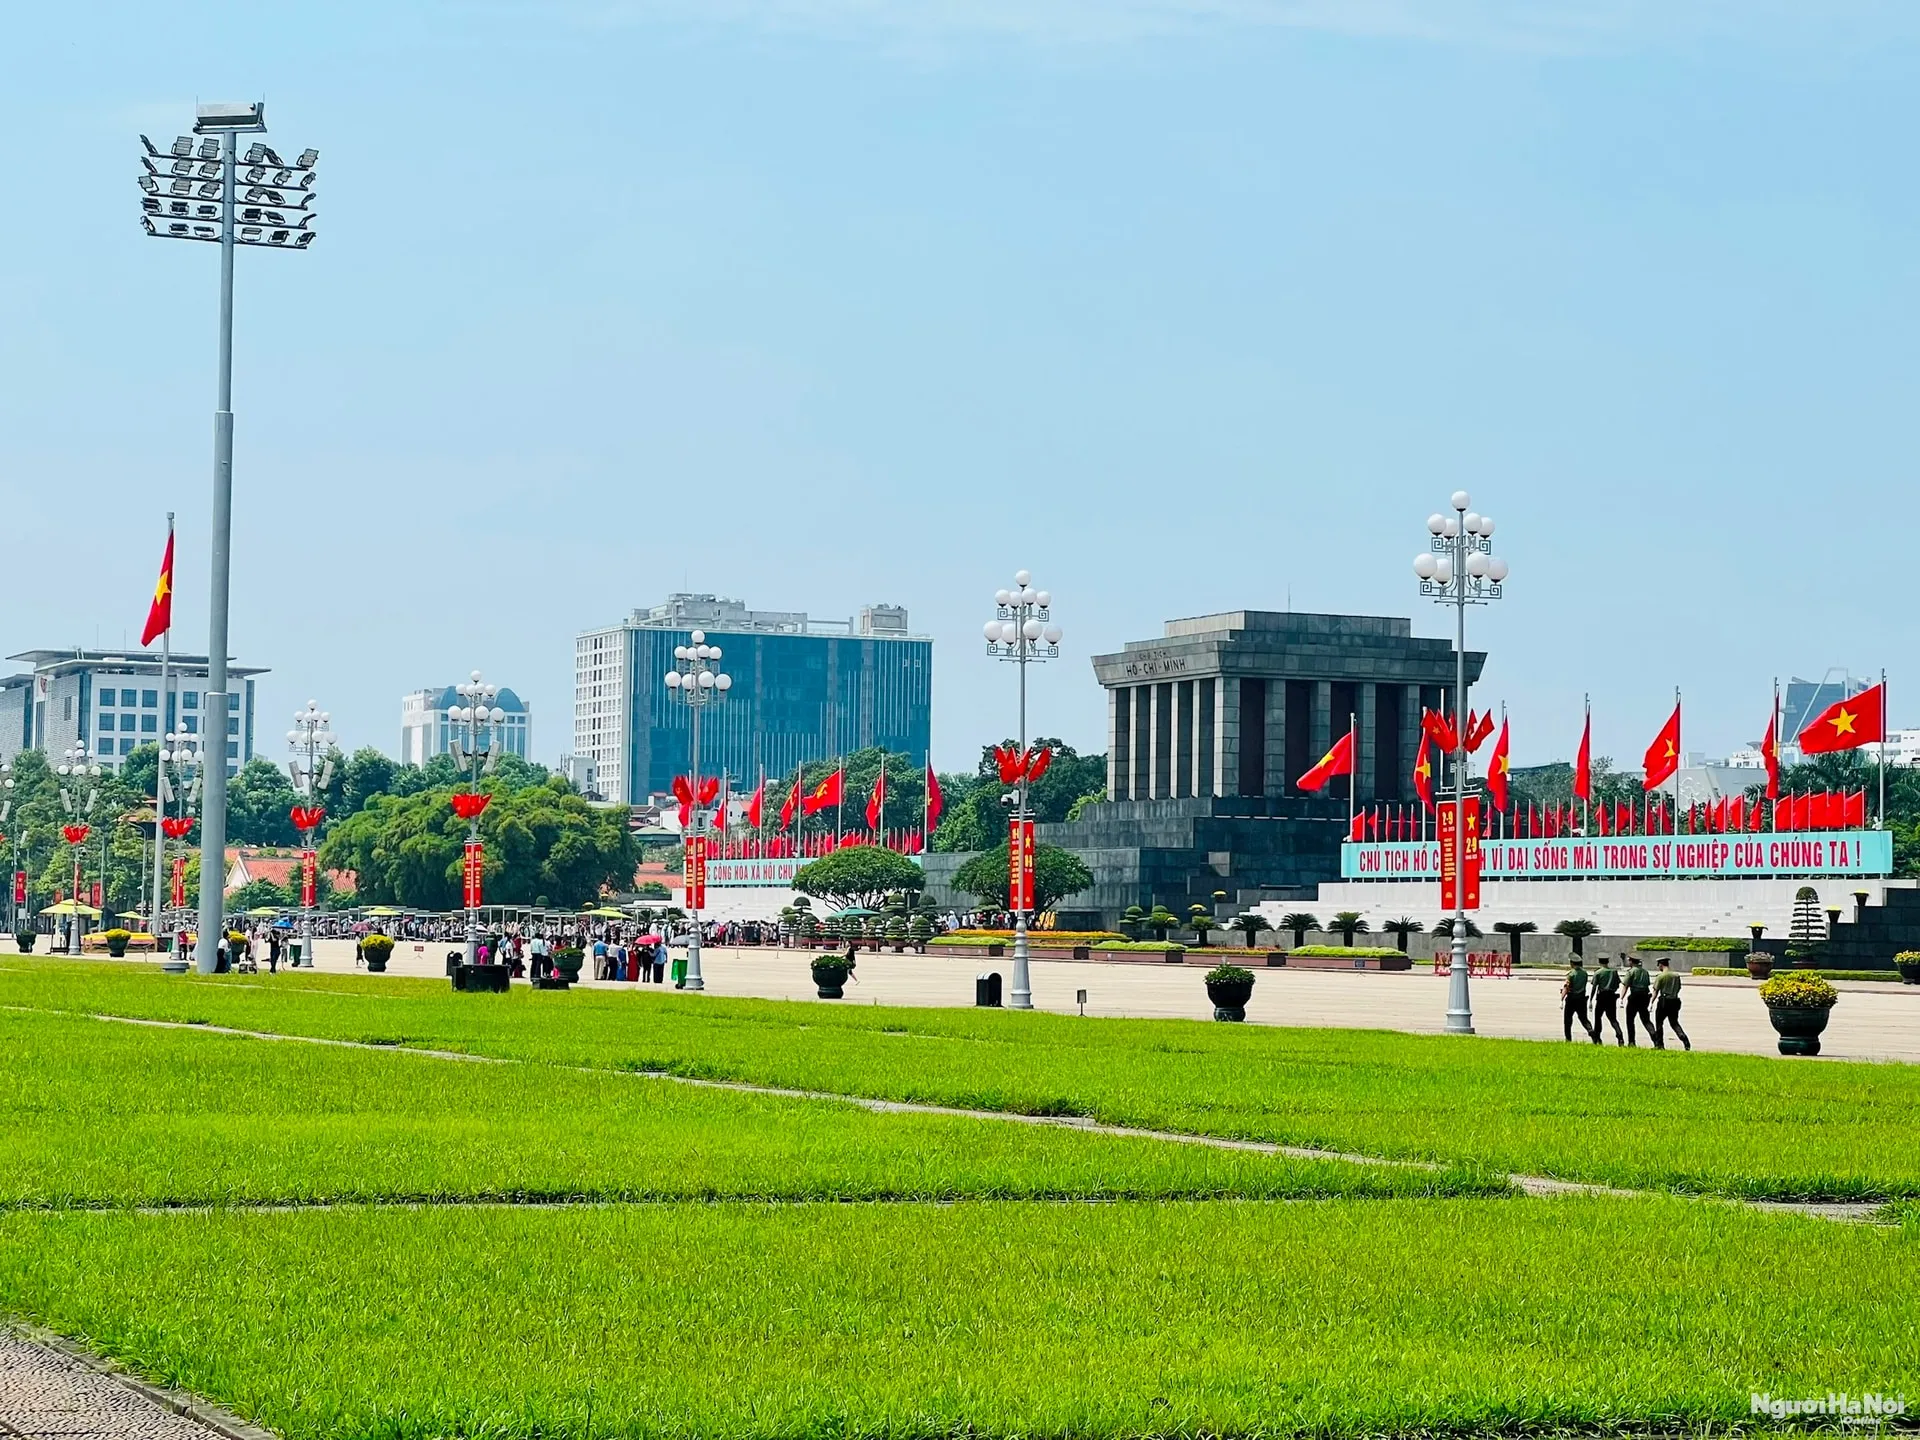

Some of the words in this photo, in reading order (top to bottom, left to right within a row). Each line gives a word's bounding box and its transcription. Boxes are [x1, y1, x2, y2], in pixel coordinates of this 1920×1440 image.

[1360, 844, 1380, 872] CHỦ
[1384, 850, 1408, 876] TỊCH
[1413, 843, 1428, 871] HỒ
[1492, 843, 1503, 870] VĨ
[1508, 847, 1528, 874] ĐẠI
[1534, 840, 1568, 870] SỐNG
[1573, 841, 1597, 870] MÃI
[1603, 845, 1647, 869] TRONG
[1653, 841, 1671, 873] SỰ
[1676, 838, 1729, 873] NGHIỆP
[1735, 835, 1763, 868] CỦA
[1770, 836, 1823, 868] CHÚNG
[1829, 840, 1849, 867] TA
[1465, 836, 1478, 853] 2-9
